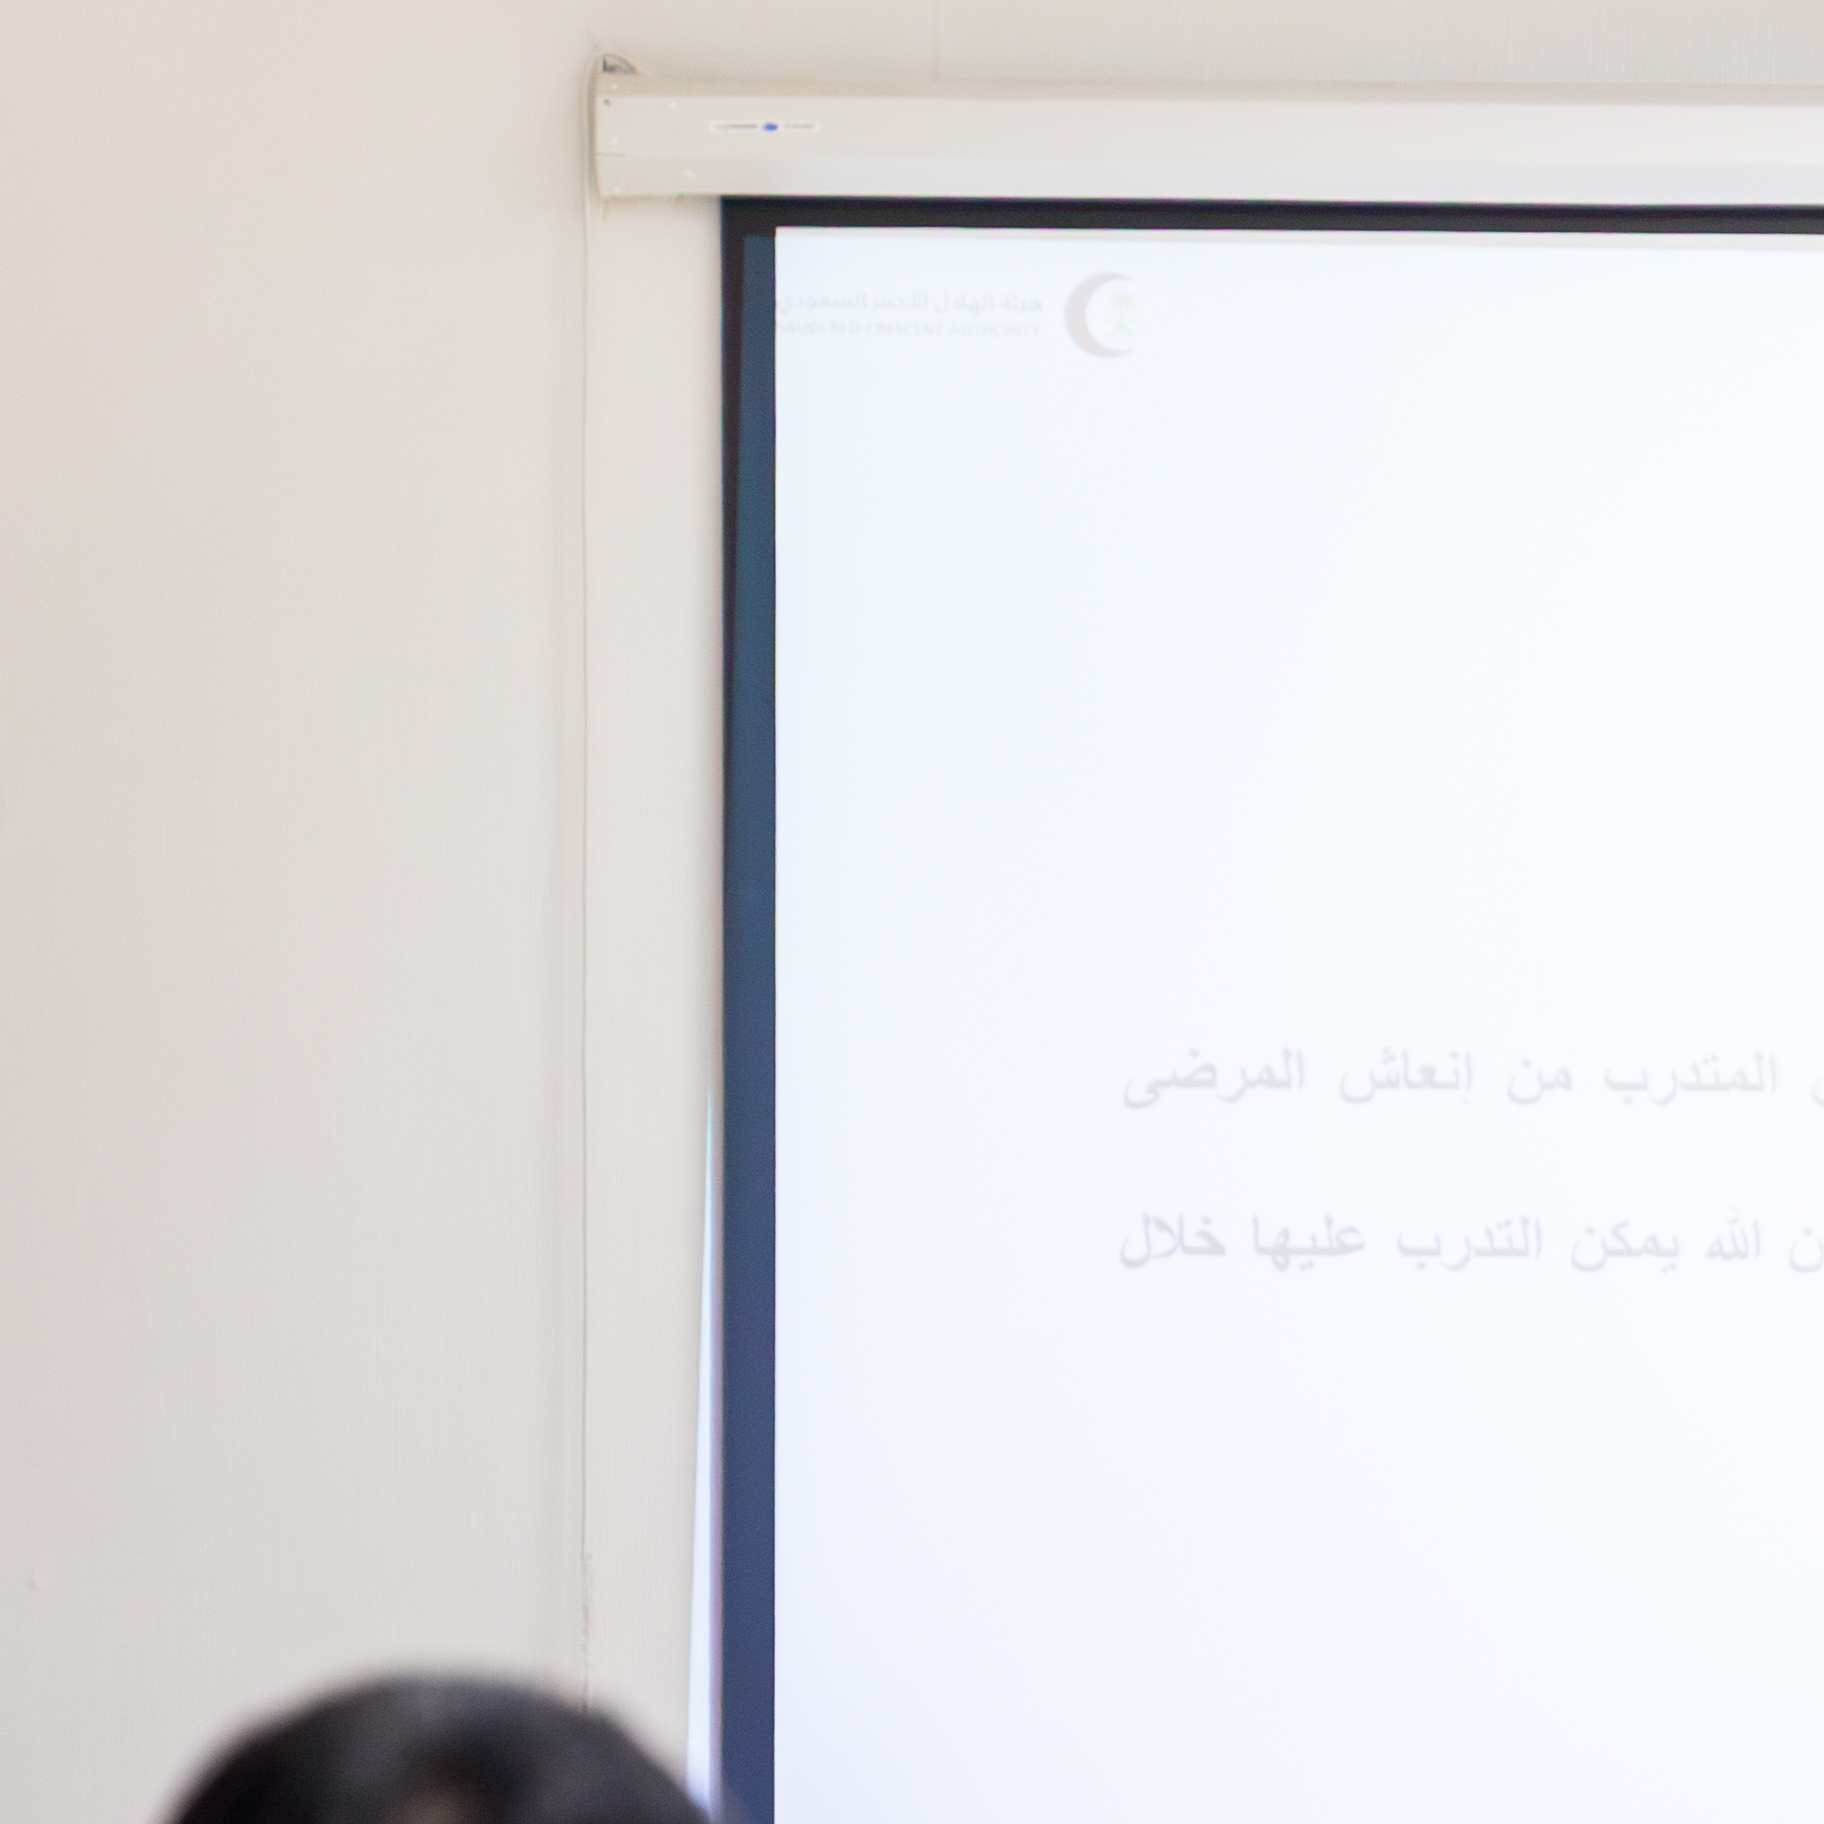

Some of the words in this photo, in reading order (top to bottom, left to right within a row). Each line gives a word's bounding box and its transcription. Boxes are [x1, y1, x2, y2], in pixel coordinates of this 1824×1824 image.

[1123, 1047, 1304, 1110] المرضى
[1339, 1047, 1473, 1105] إنعاش
[1507, 1059, 1573, 1106] من
[1604, 1051, 1777, 1106] المتدرب
[1120, 1213, 1226, 1269] خلال
[1252, 1215, 1365, 1272] عليها
[1397, 1216, 1542, 1272] التدرب
[1571, 1220, 1679, 1273] يمكن
[1705, 1206, 1761, 1261] الله
